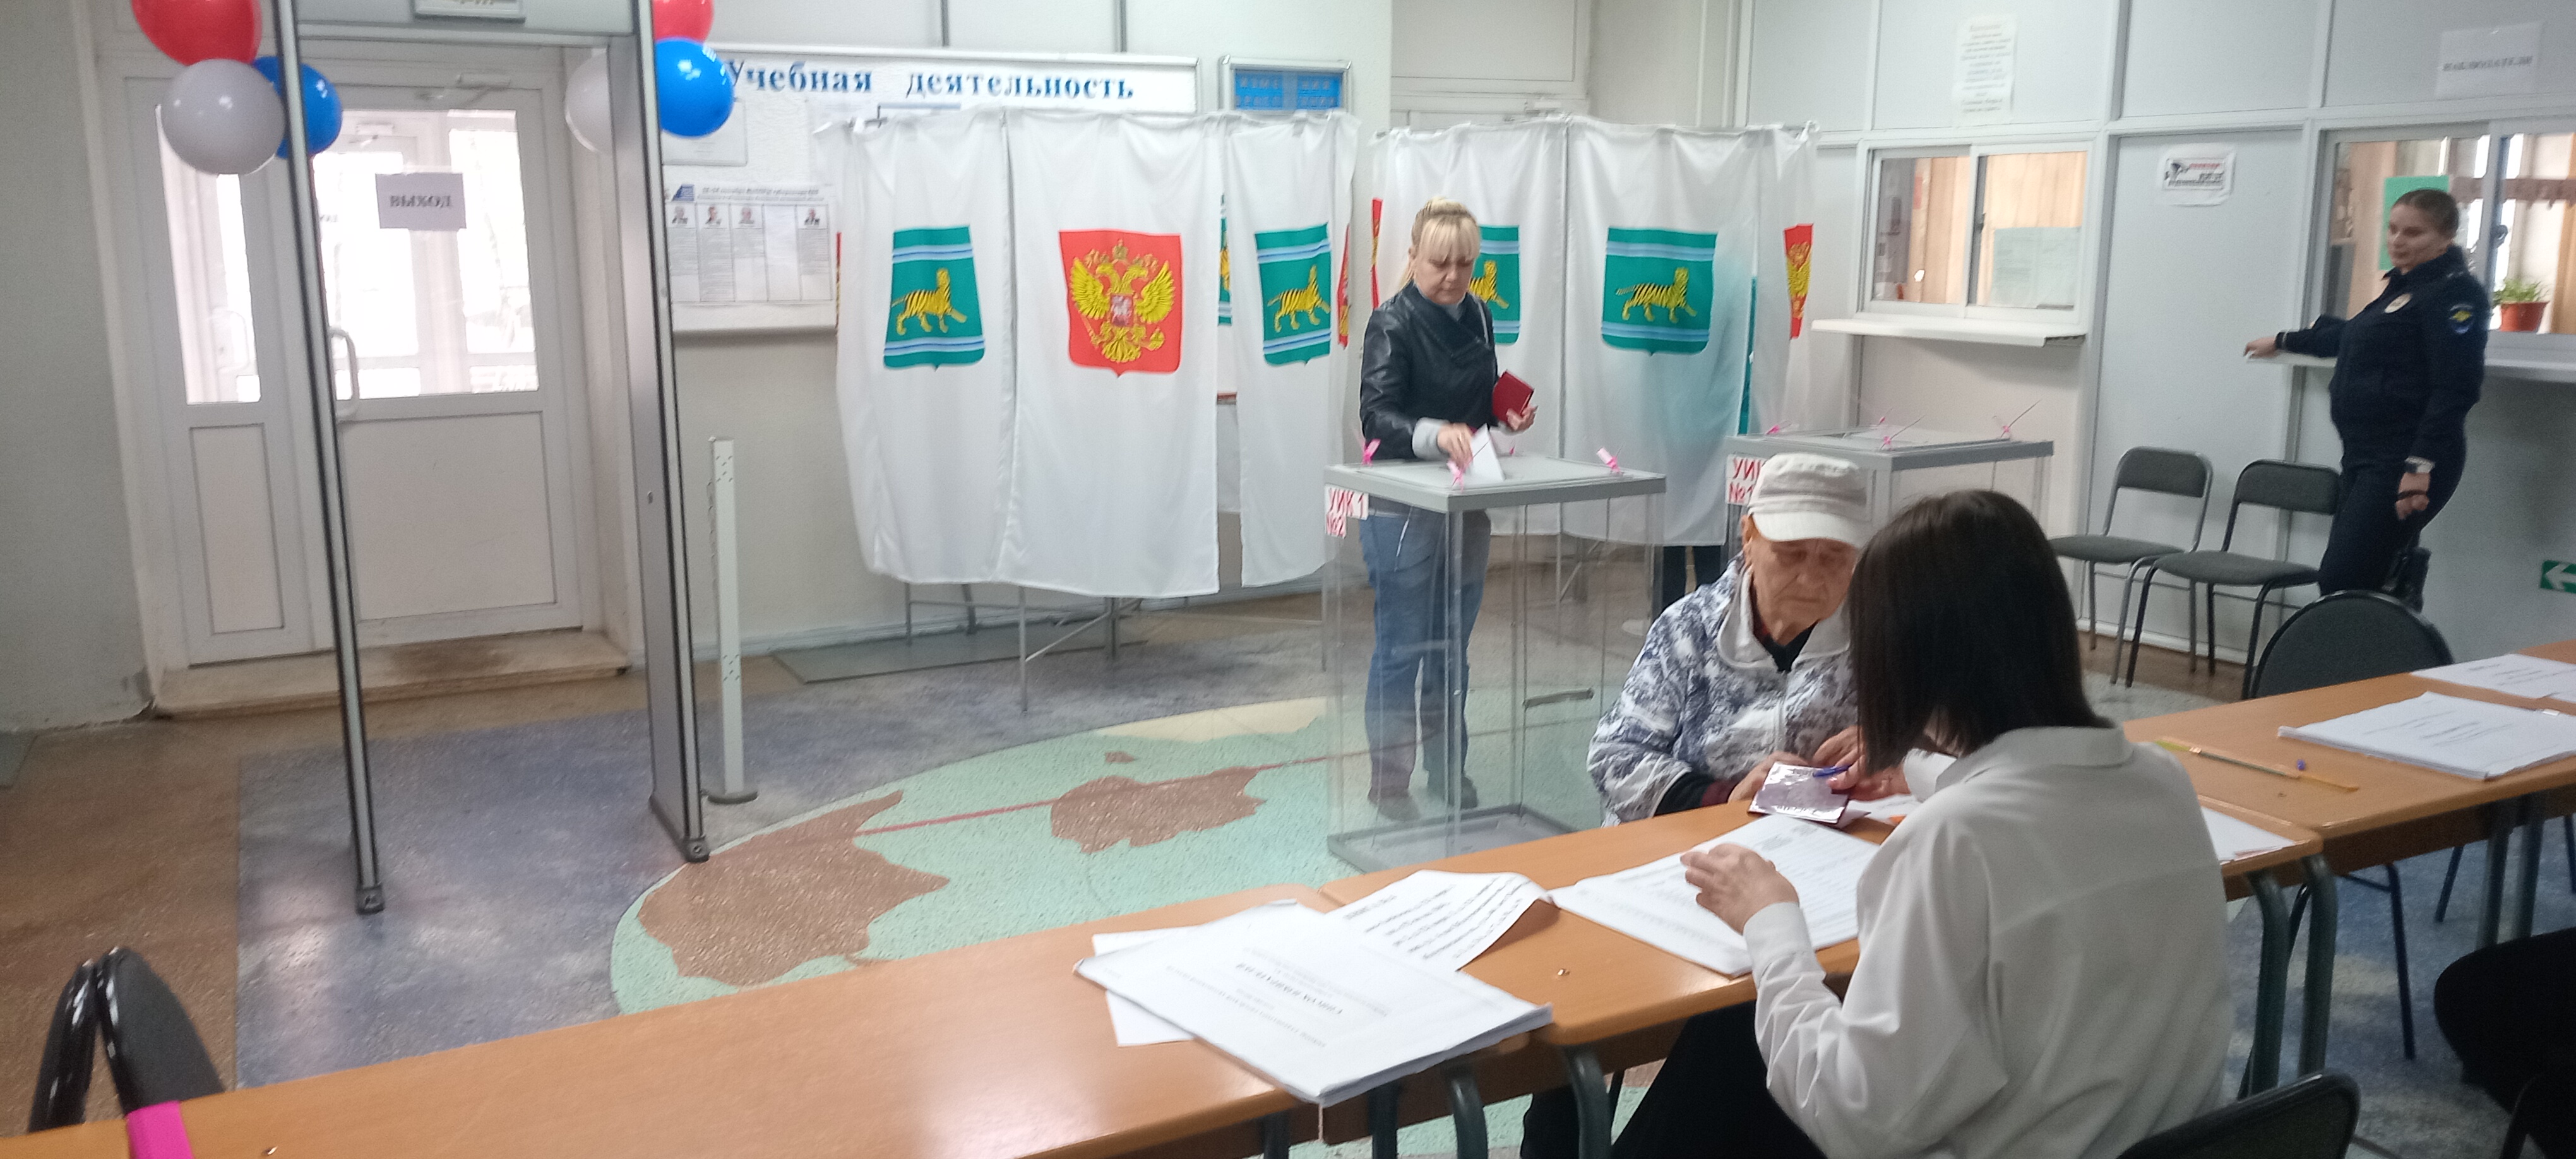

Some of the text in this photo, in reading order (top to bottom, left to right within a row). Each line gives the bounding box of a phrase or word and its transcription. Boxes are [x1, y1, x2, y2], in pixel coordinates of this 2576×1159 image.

[729, 60, 1134, 99] Учебная деятельность
[390, 194, 451, 208] ВЫХОД
[1328, 487, 1355, 517] УИК
